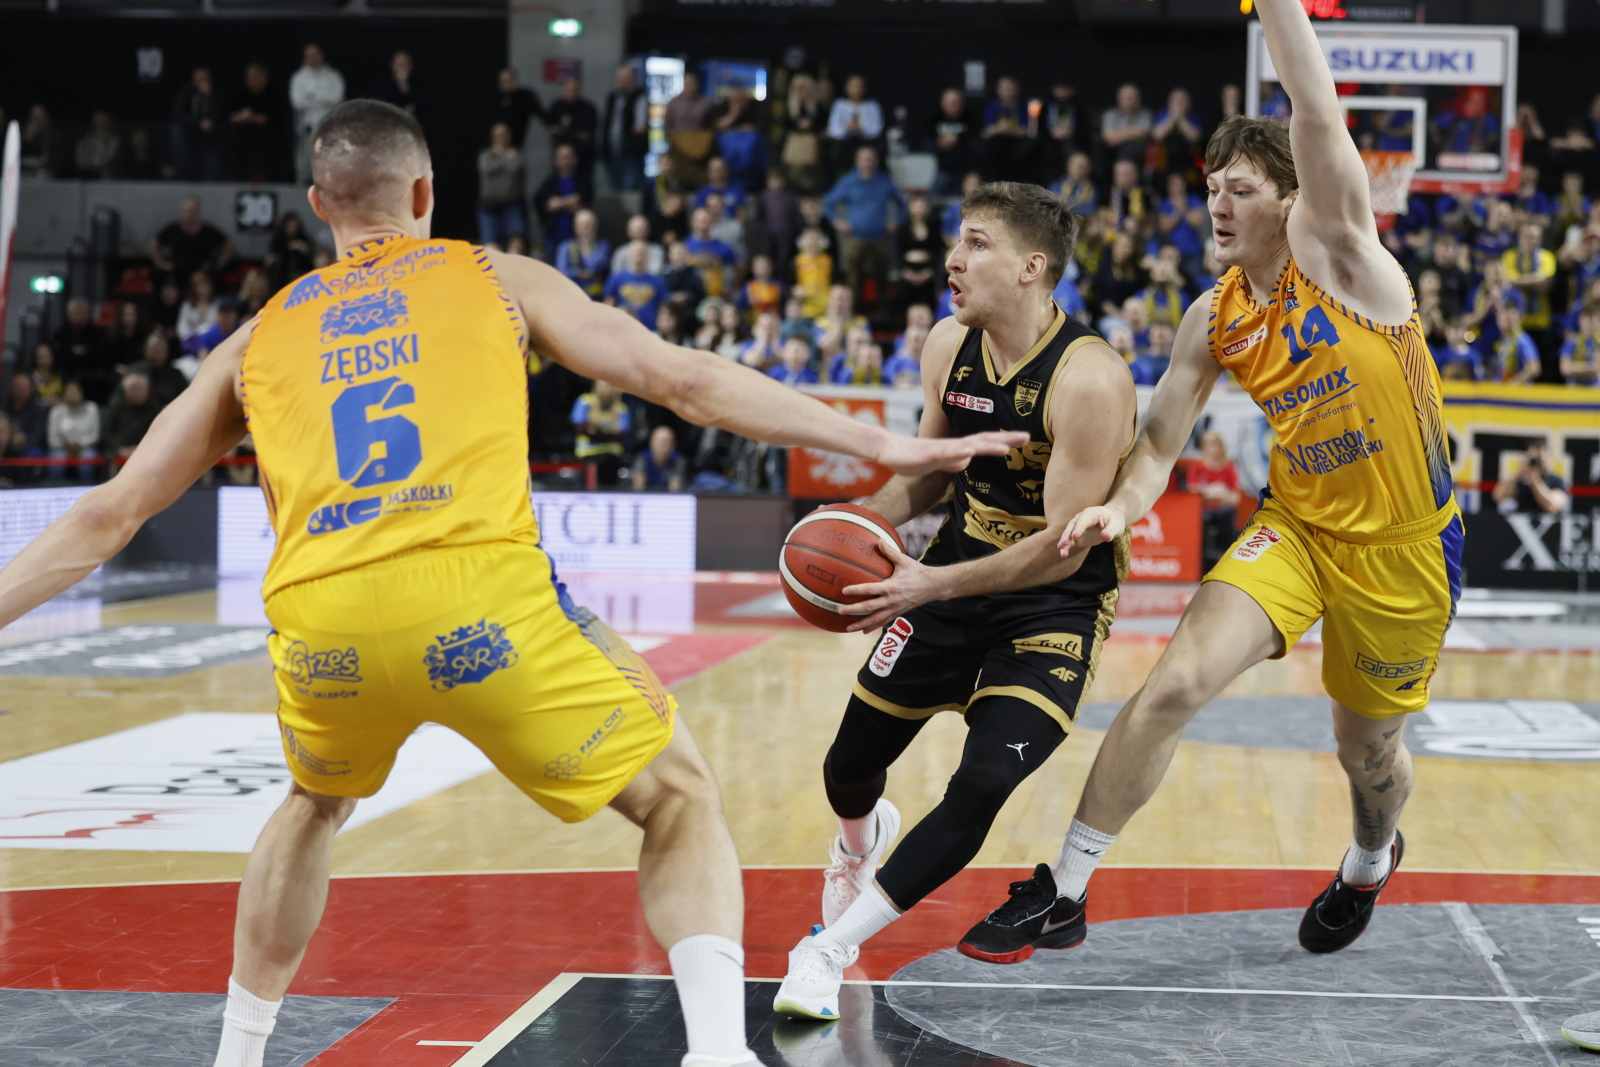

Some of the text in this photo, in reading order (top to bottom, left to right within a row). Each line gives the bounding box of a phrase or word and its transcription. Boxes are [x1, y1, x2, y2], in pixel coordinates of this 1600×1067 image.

[1330, 49, 1475, 72] SUZUKI
[1224, 339, 1248, 355] ORLEN
[1280, 303, 1342, 366] 14
[319, 333, 420, 385] ZĘBSKI
[1262, 365, 1352, 417] TASOMIX
[331, 375, 424, 489] 6
[820, 528, 876, 557] molten
[1048, 666, 1079, 683] 4F
